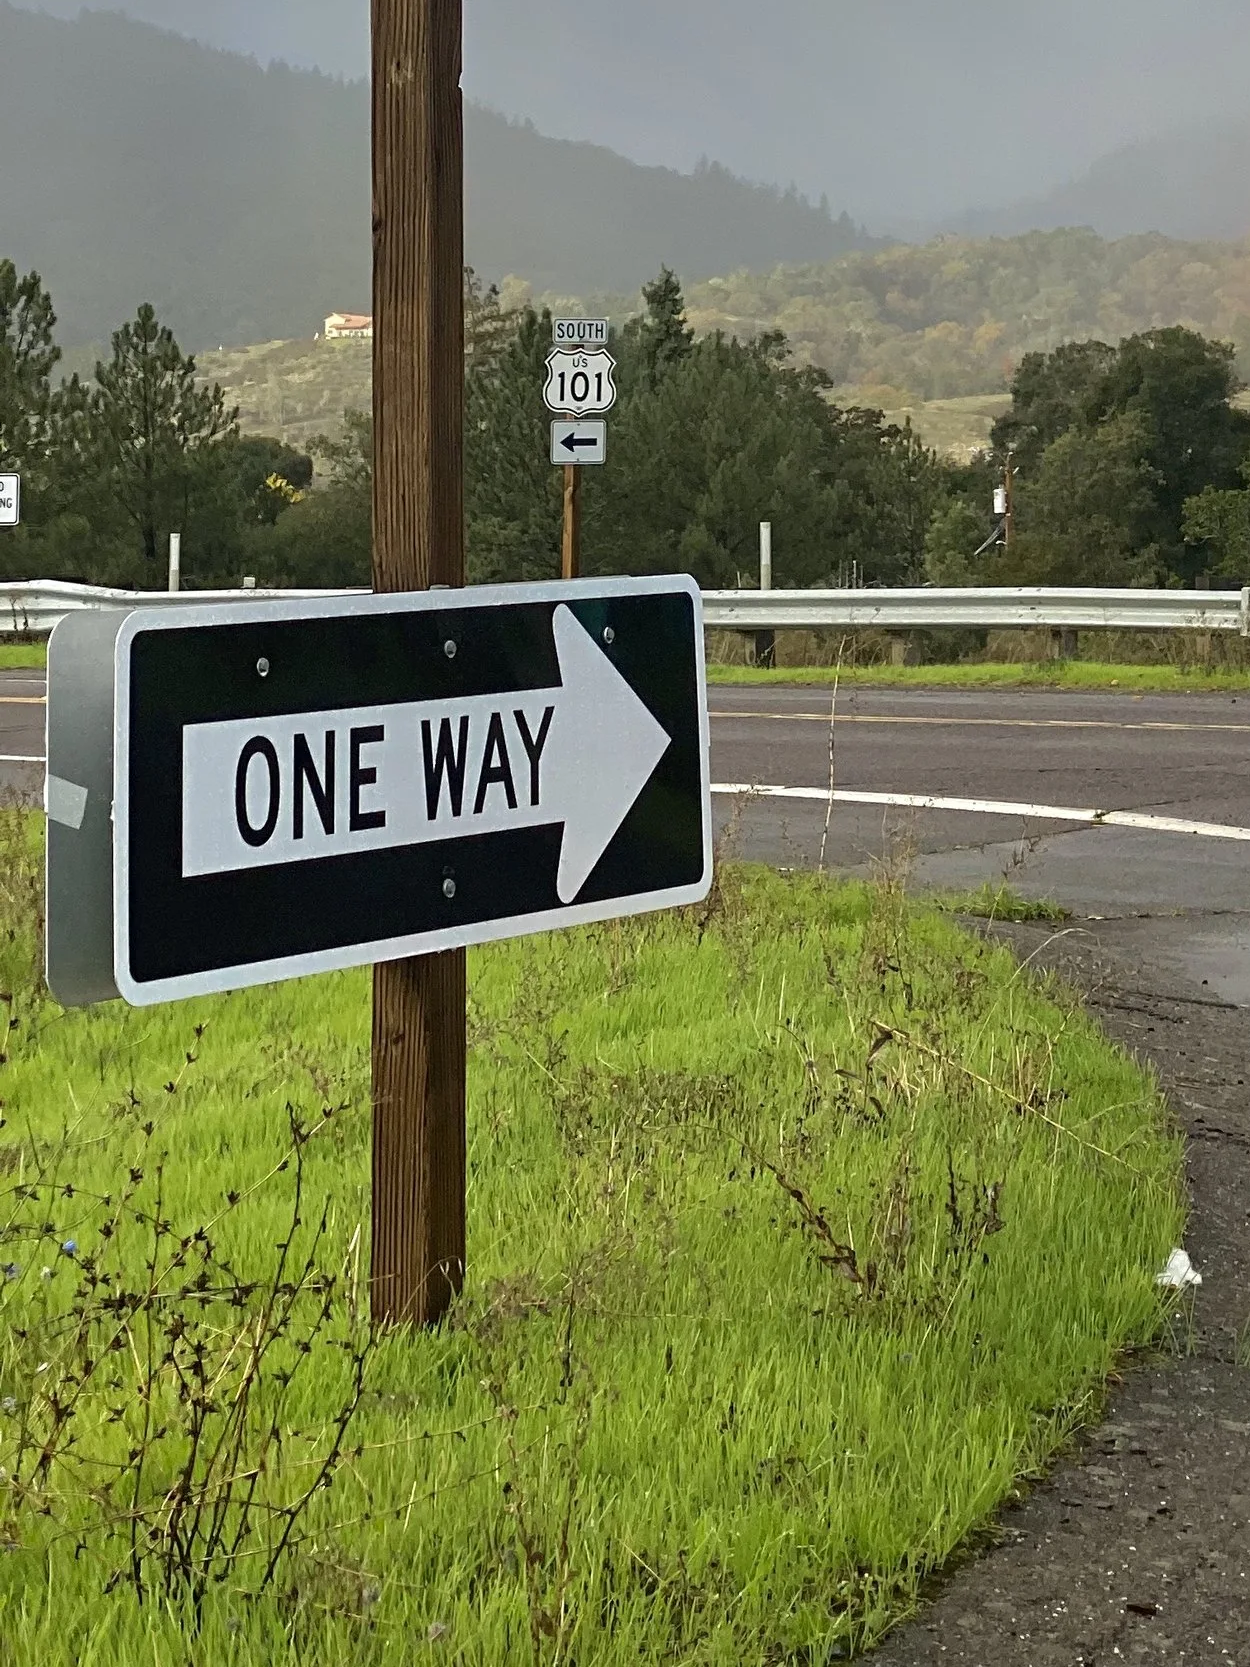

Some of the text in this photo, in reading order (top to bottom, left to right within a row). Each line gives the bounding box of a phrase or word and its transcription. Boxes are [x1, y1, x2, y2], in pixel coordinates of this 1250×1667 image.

[557, 322, 604, 339] SOUTH
[572, 358, 588, 368] US
[558, 371, 602, 402] 101
[235, 705, 555, 847] ONE WAY
